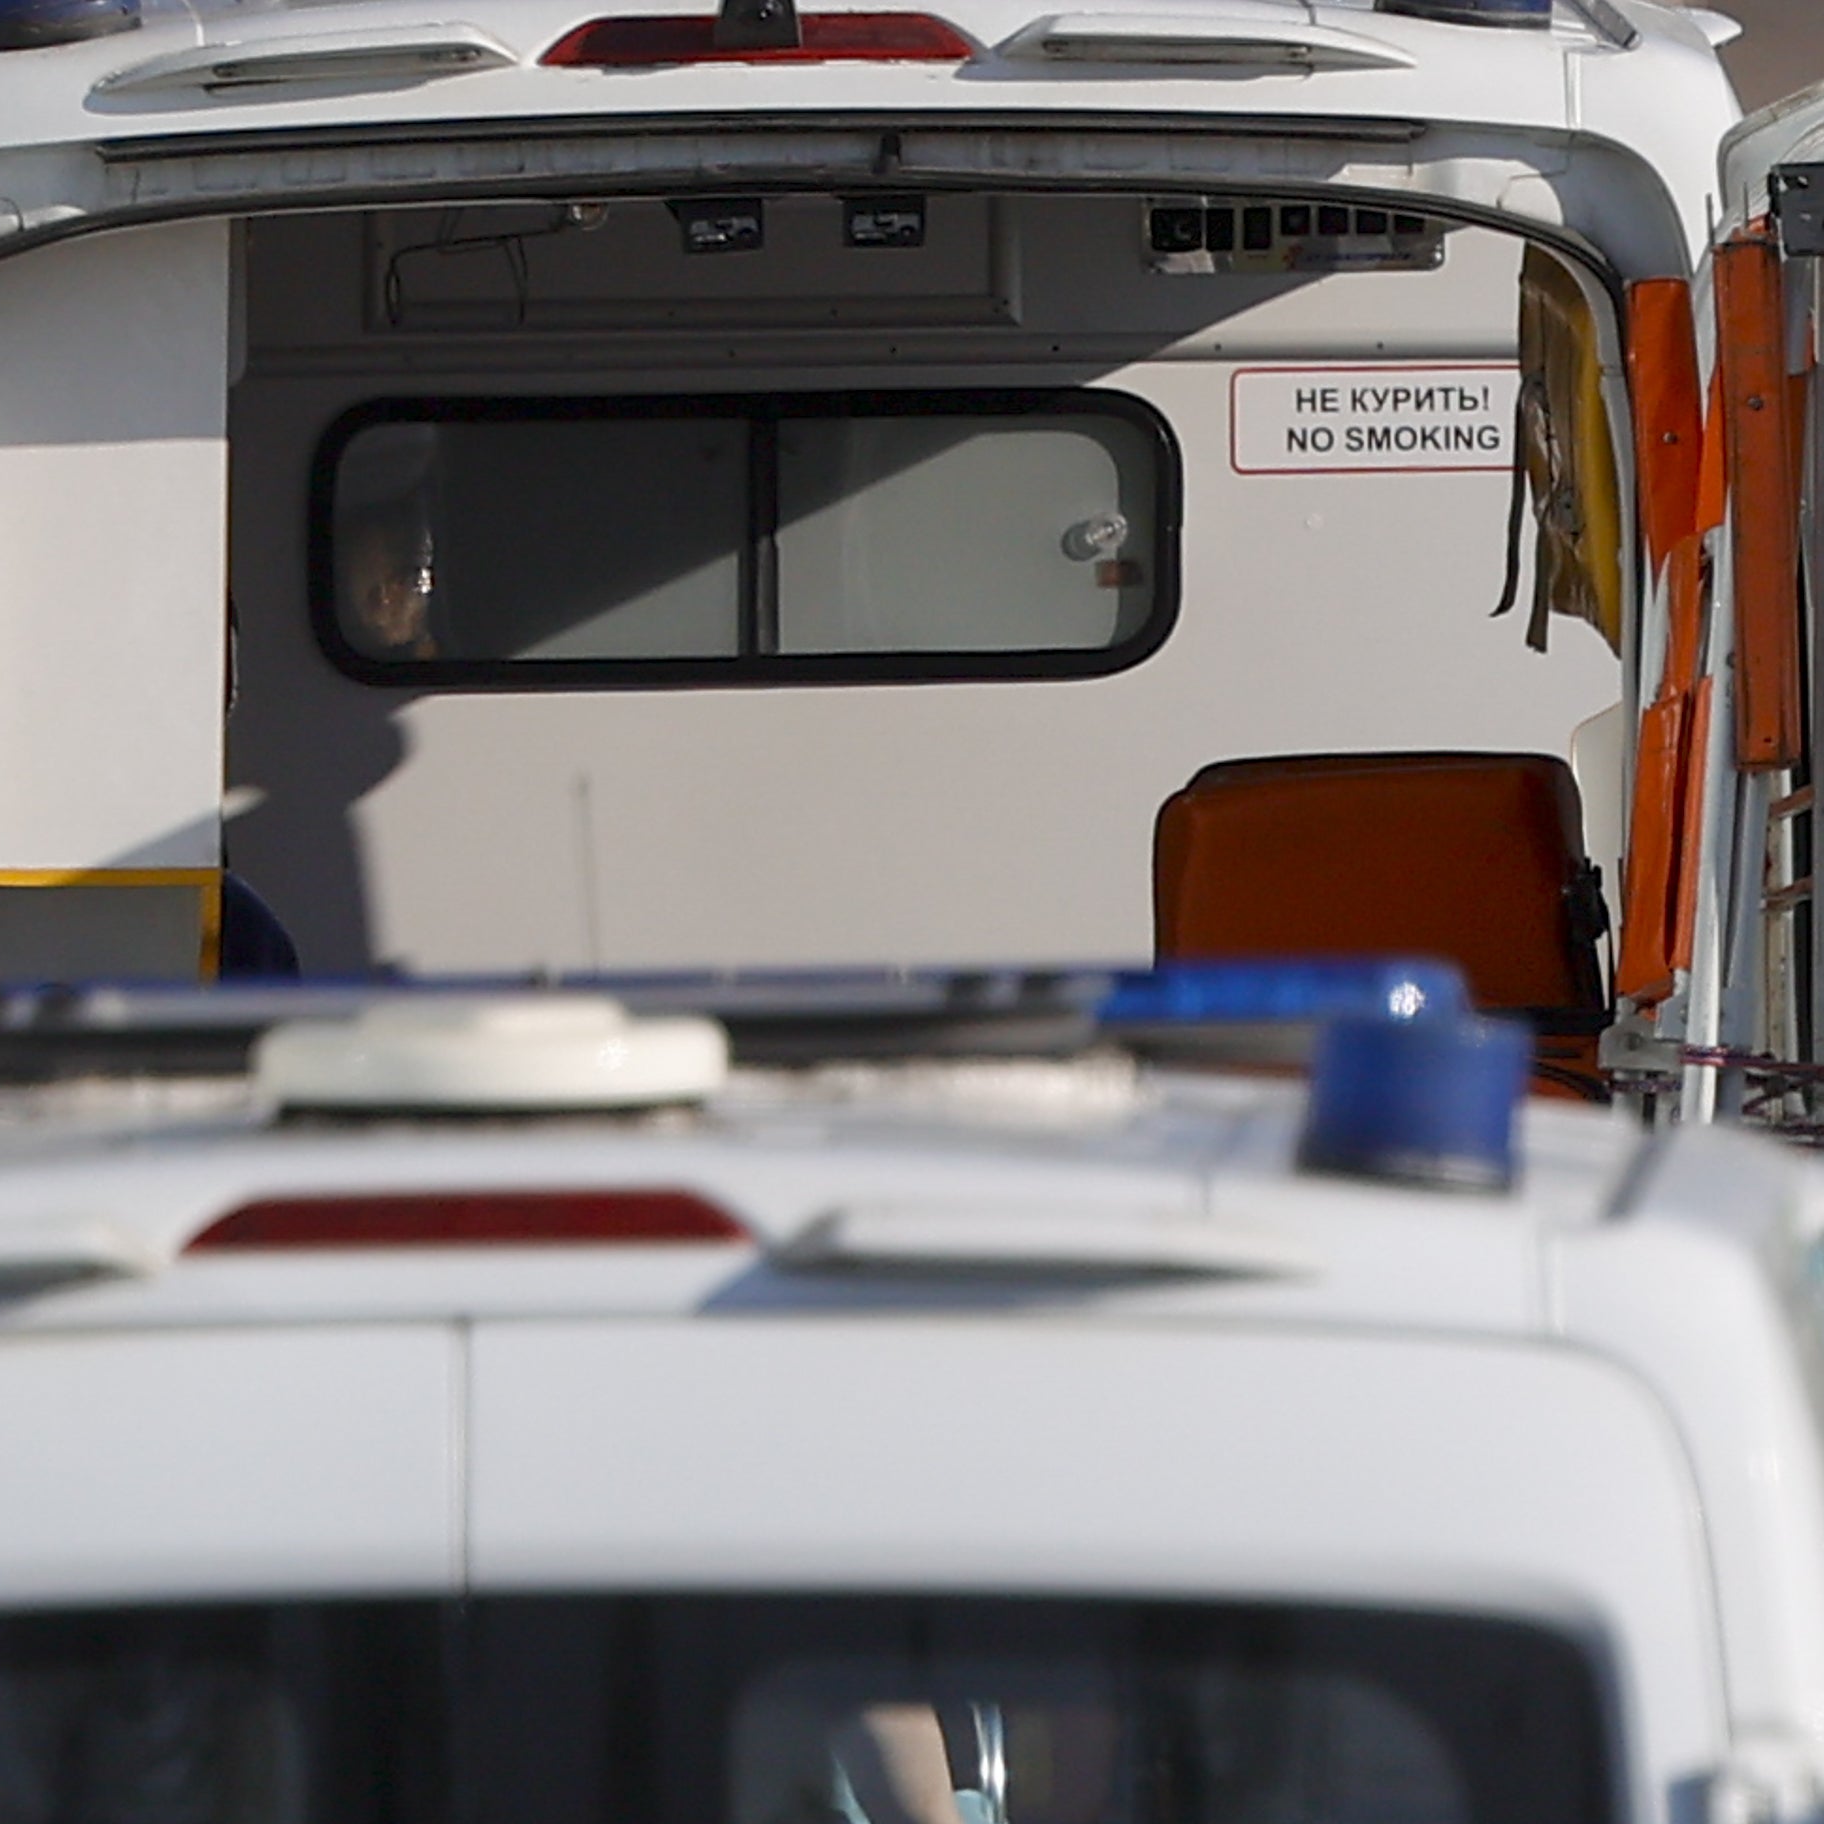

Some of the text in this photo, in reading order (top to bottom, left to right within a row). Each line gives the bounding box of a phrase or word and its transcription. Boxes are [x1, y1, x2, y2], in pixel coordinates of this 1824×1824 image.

[1295, 385, 1489, 413] НЕ КУРИТЬ!
[1286, 424, 1501, 453] NO SMOKING
